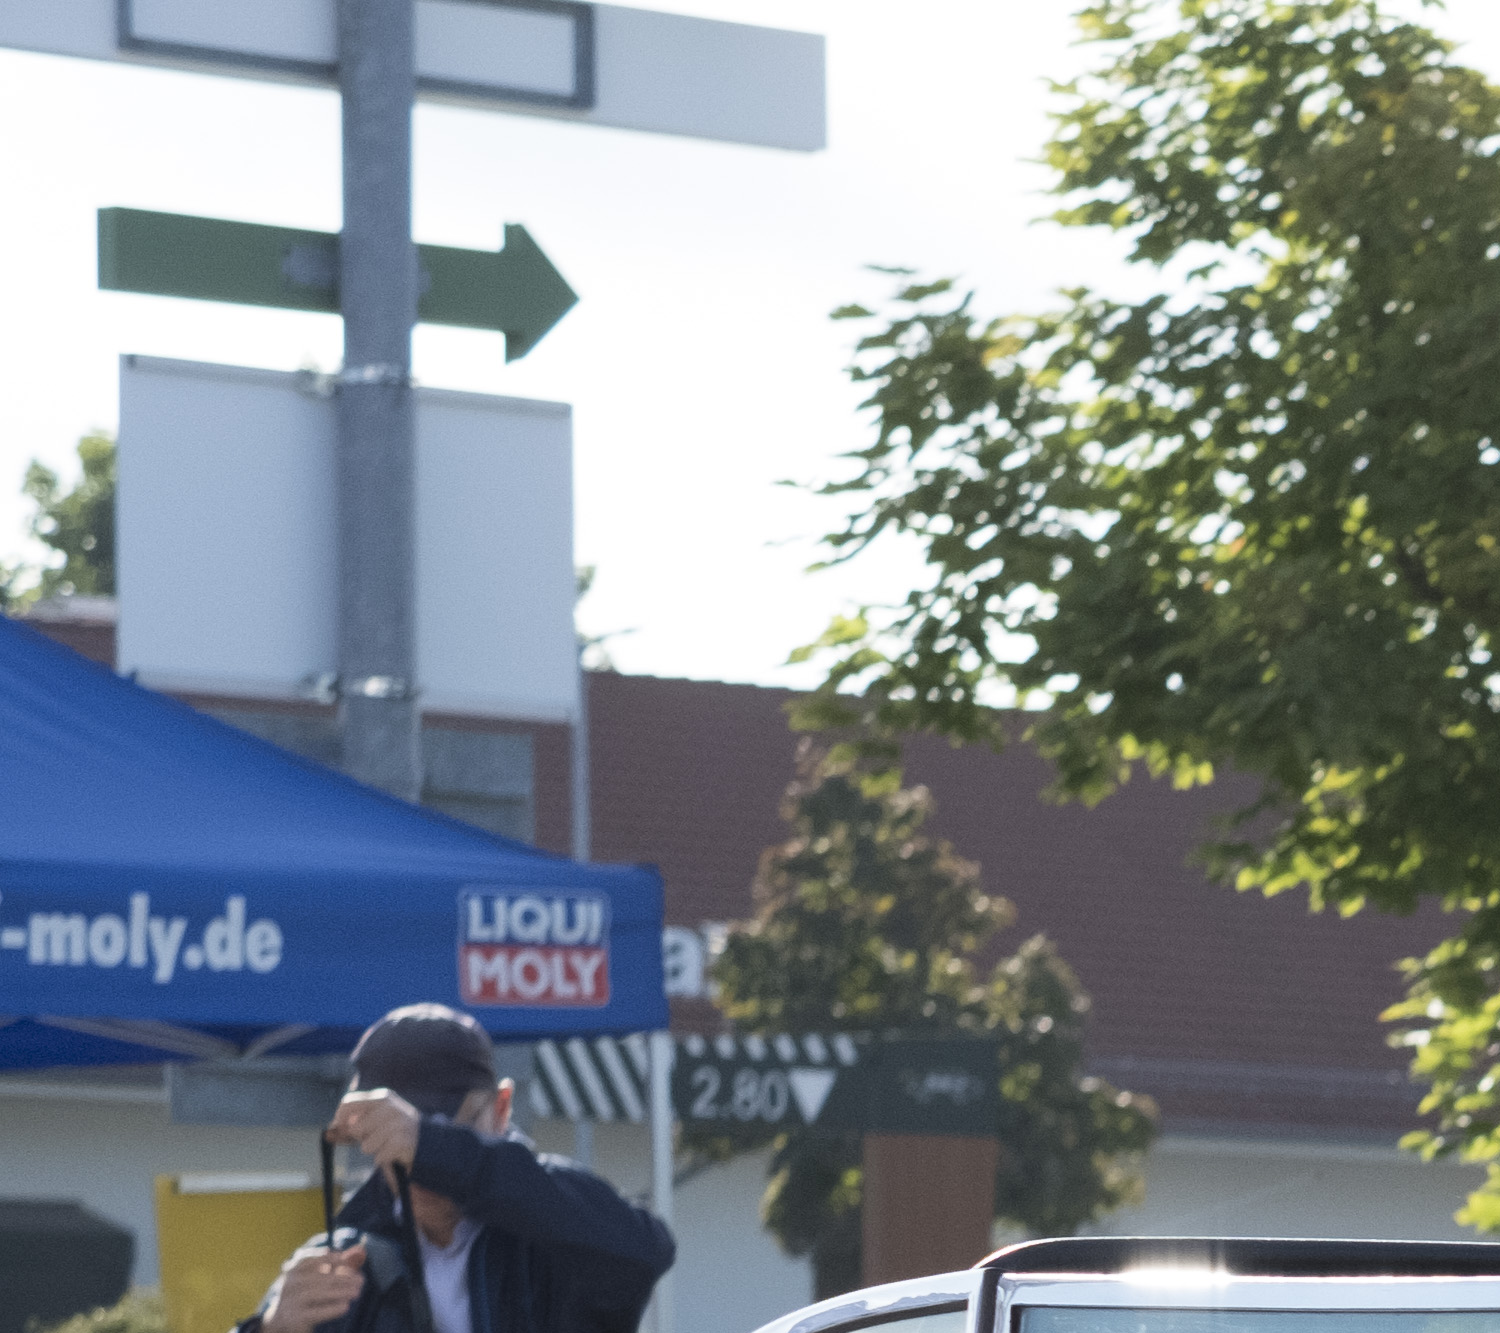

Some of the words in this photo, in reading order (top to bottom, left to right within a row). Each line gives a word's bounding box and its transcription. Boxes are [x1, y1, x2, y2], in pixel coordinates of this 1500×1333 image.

[0, 890, 284, 985] -moly.de
[467, 893, 602, 944] LIQUI
[467, 950, 602, 999] MOLY
[690, 1065, 789, 1122] 2.80
